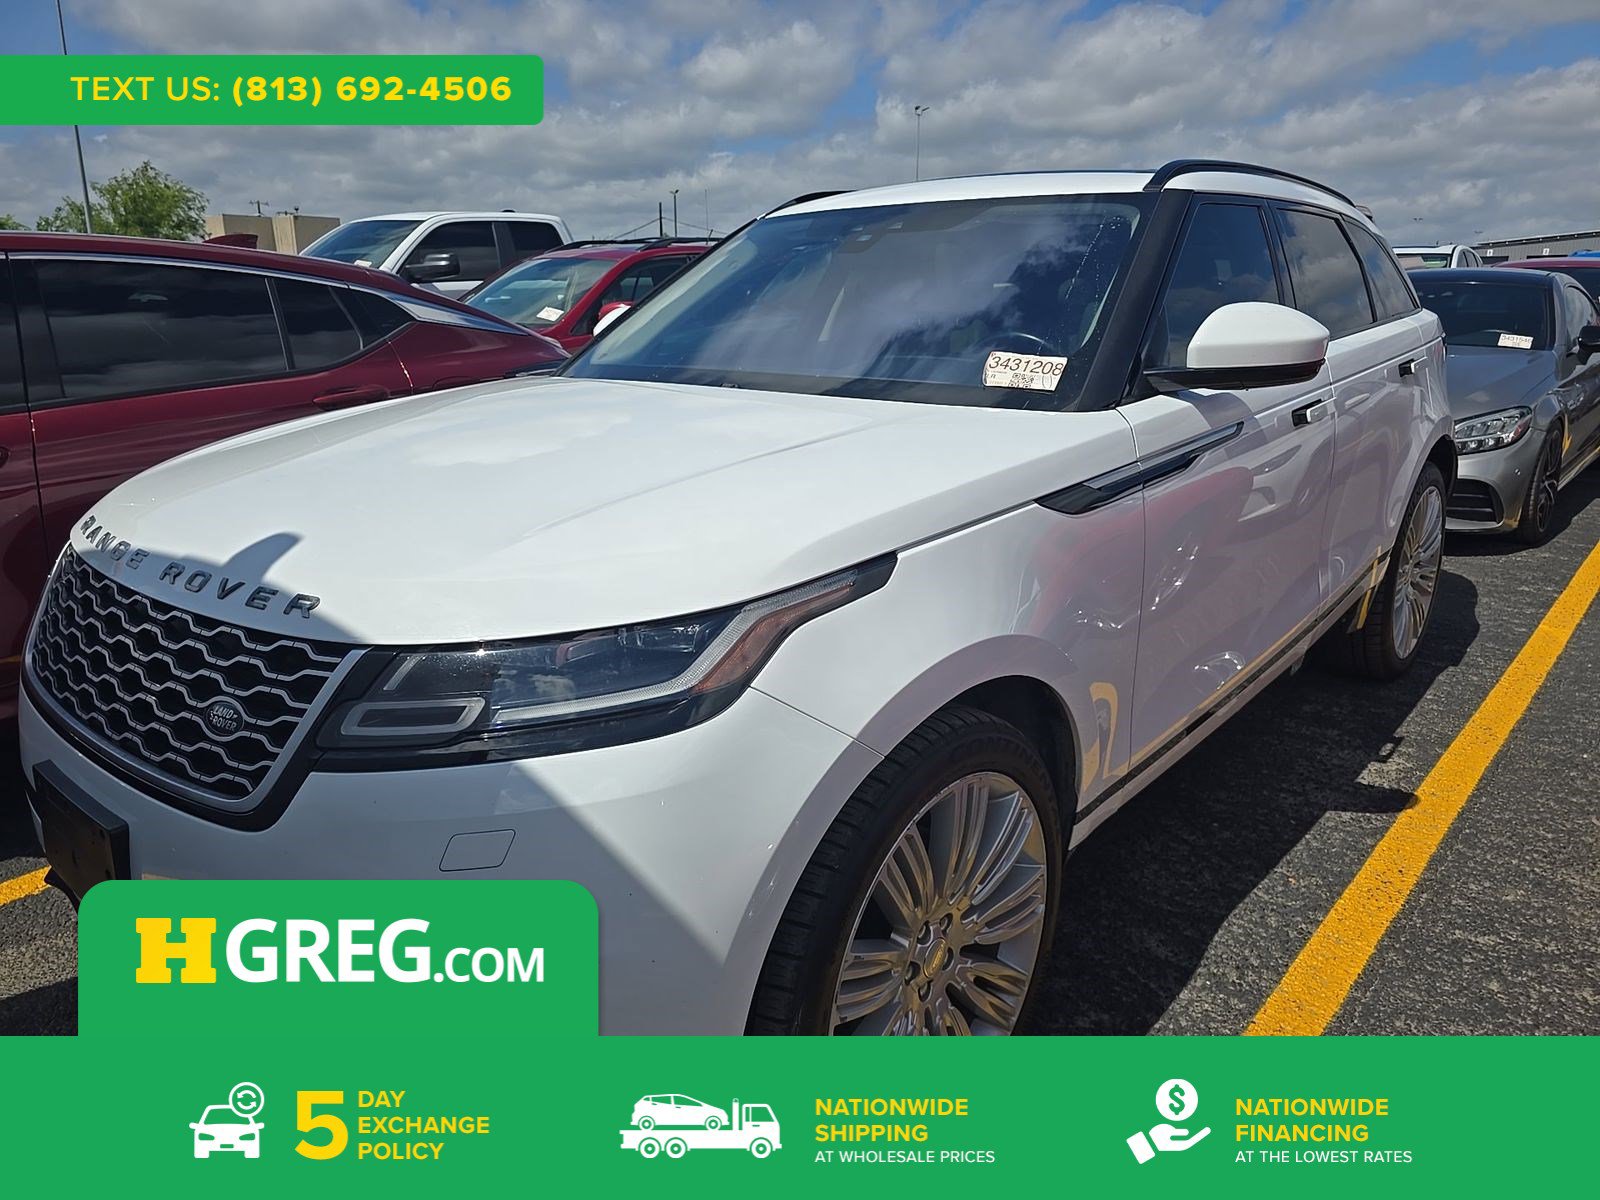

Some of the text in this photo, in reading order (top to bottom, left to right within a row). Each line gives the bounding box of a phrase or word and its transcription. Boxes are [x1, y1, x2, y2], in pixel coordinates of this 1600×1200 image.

[989, 356, 1065, 376] 3431208
[80, 515, 321, 618] RANGE ROVER
[213, 705, 234, 719] LAND
[212, 715, 237, 732] ROVER
